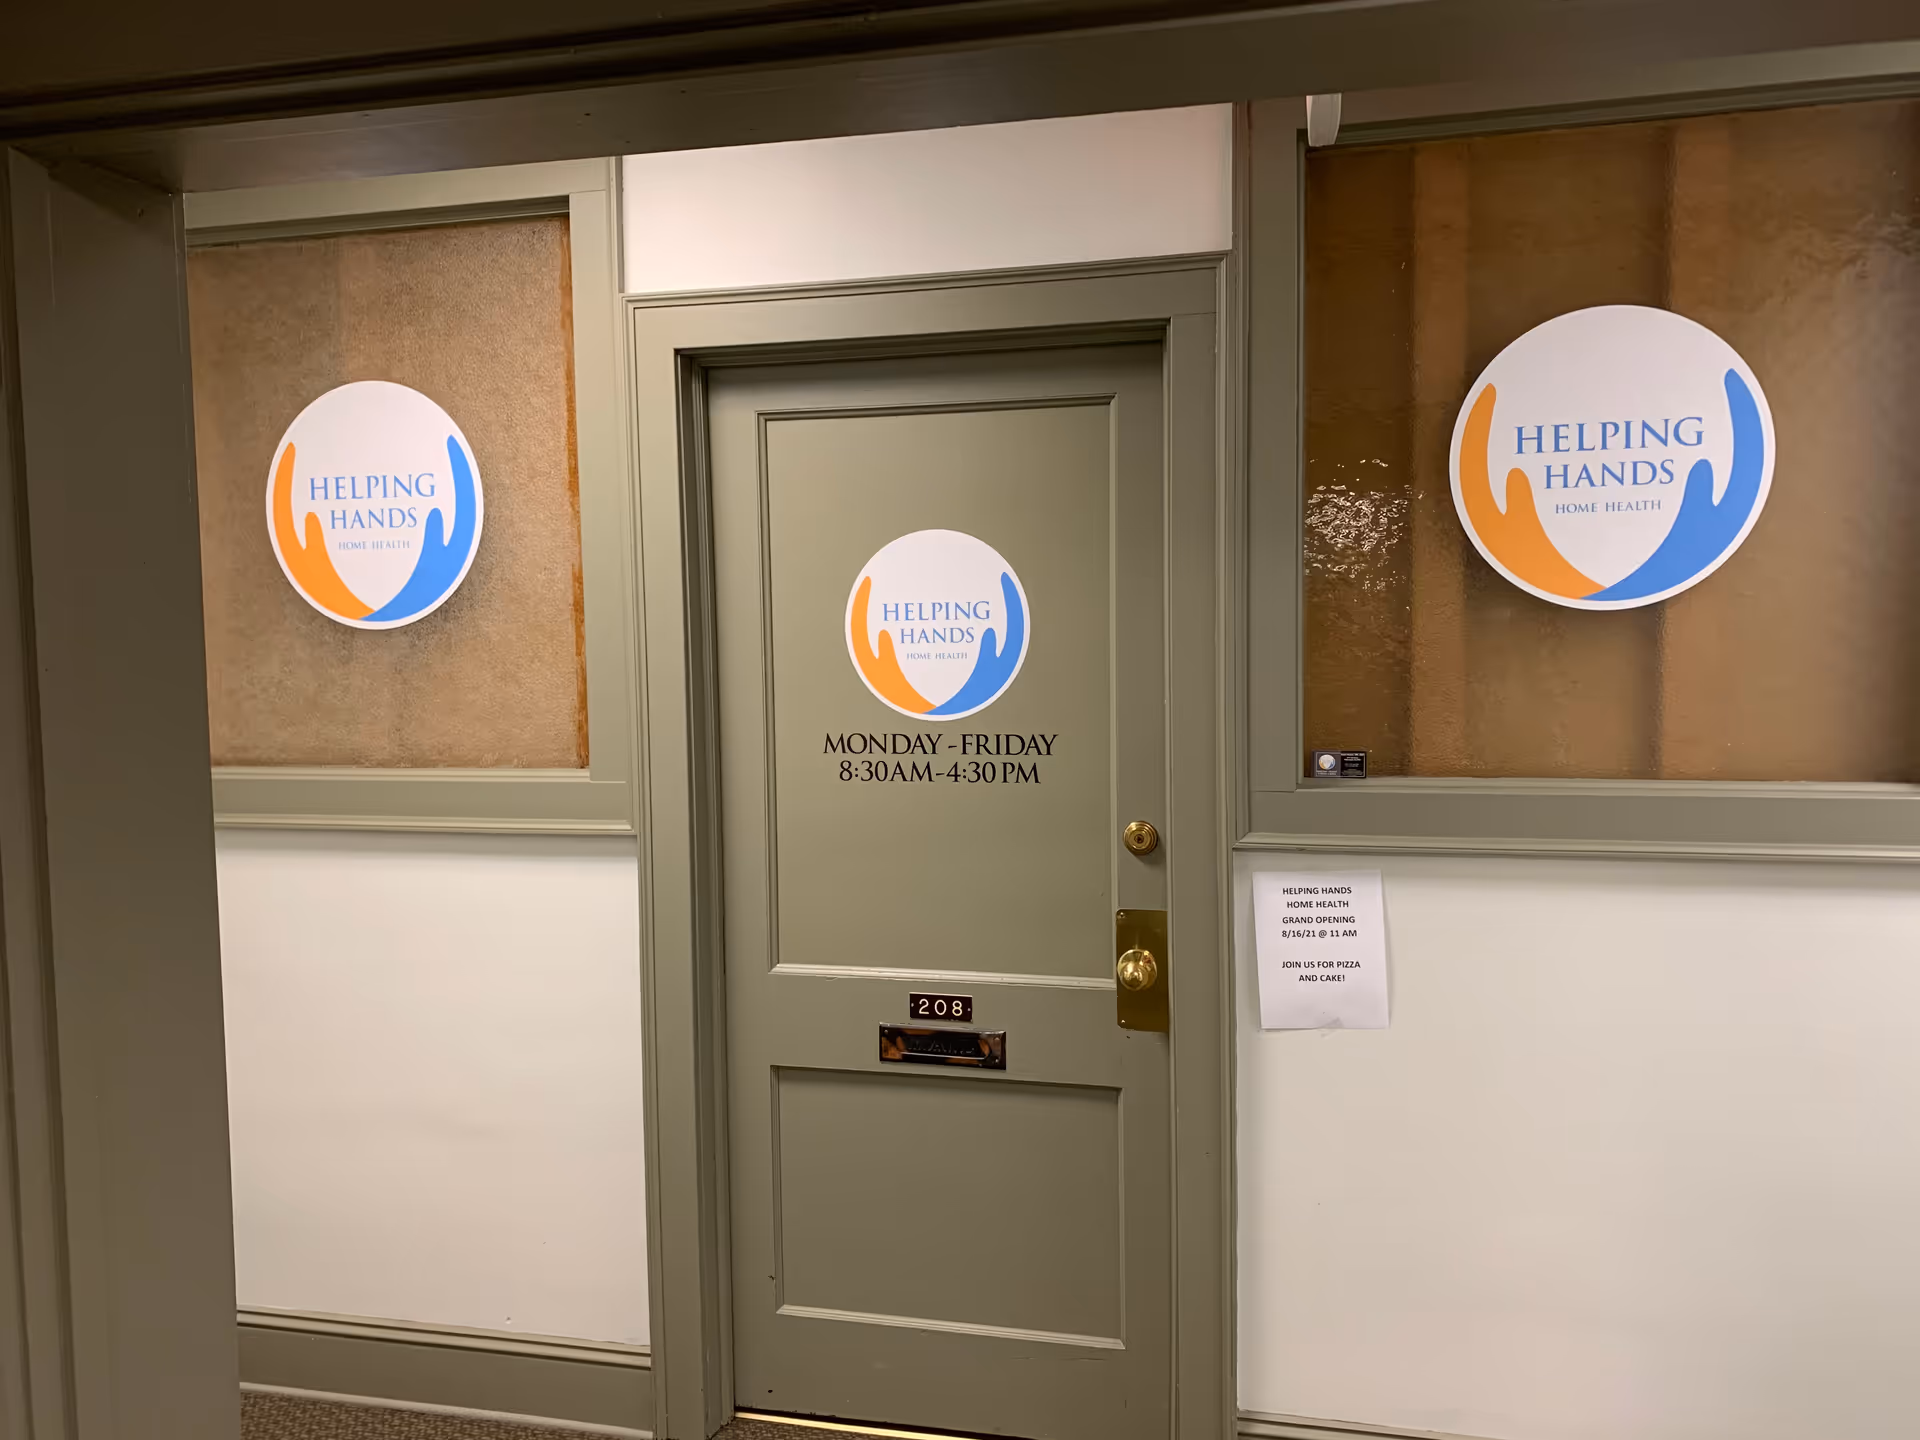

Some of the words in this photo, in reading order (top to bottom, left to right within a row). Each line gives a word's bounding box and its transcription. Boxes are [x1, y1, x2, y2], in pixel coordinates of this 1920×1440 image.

[1514, 417, 1704, 454] HELPING
[1544, 459, 1674, 489] HANDS
[309, 473, 435, 500] HELPING
[1555, 503, 1597, 514] HOME
[1605, 500, 1661, 513] HEALTH
[330, 507, 418, 529] HANDS
[338, 541, 366, 550] HOME
[371, 541, 410, 550] HEALTH
[882, 601, 991, 621] HELPING
[900, 627, 975, 643] HANDS
[1282, 887, 1320, 895] HELPING
[1321, 887, 1353, 895] HANDS
[1286, 901, 1314, 909] HOME
[1315, 901, 1349, 909] HEALTH
[1282, 917, 1314, 925] GRAND
[1315, 916, 1356, 924] OPENING
[1281, 929, 1317, 939] 8/16/21
[1318, 929, 1328, 939] @
[1329, 930, 1340, 938] 11
[1281, 961, 1302, 969] JOIN
[1303, 961, 1316, 969] US
[1317, 961, 1335, 969] FOR
[1336, 961, 1361, 969] PIZZA
[918, 998, 963, 1017] 208
